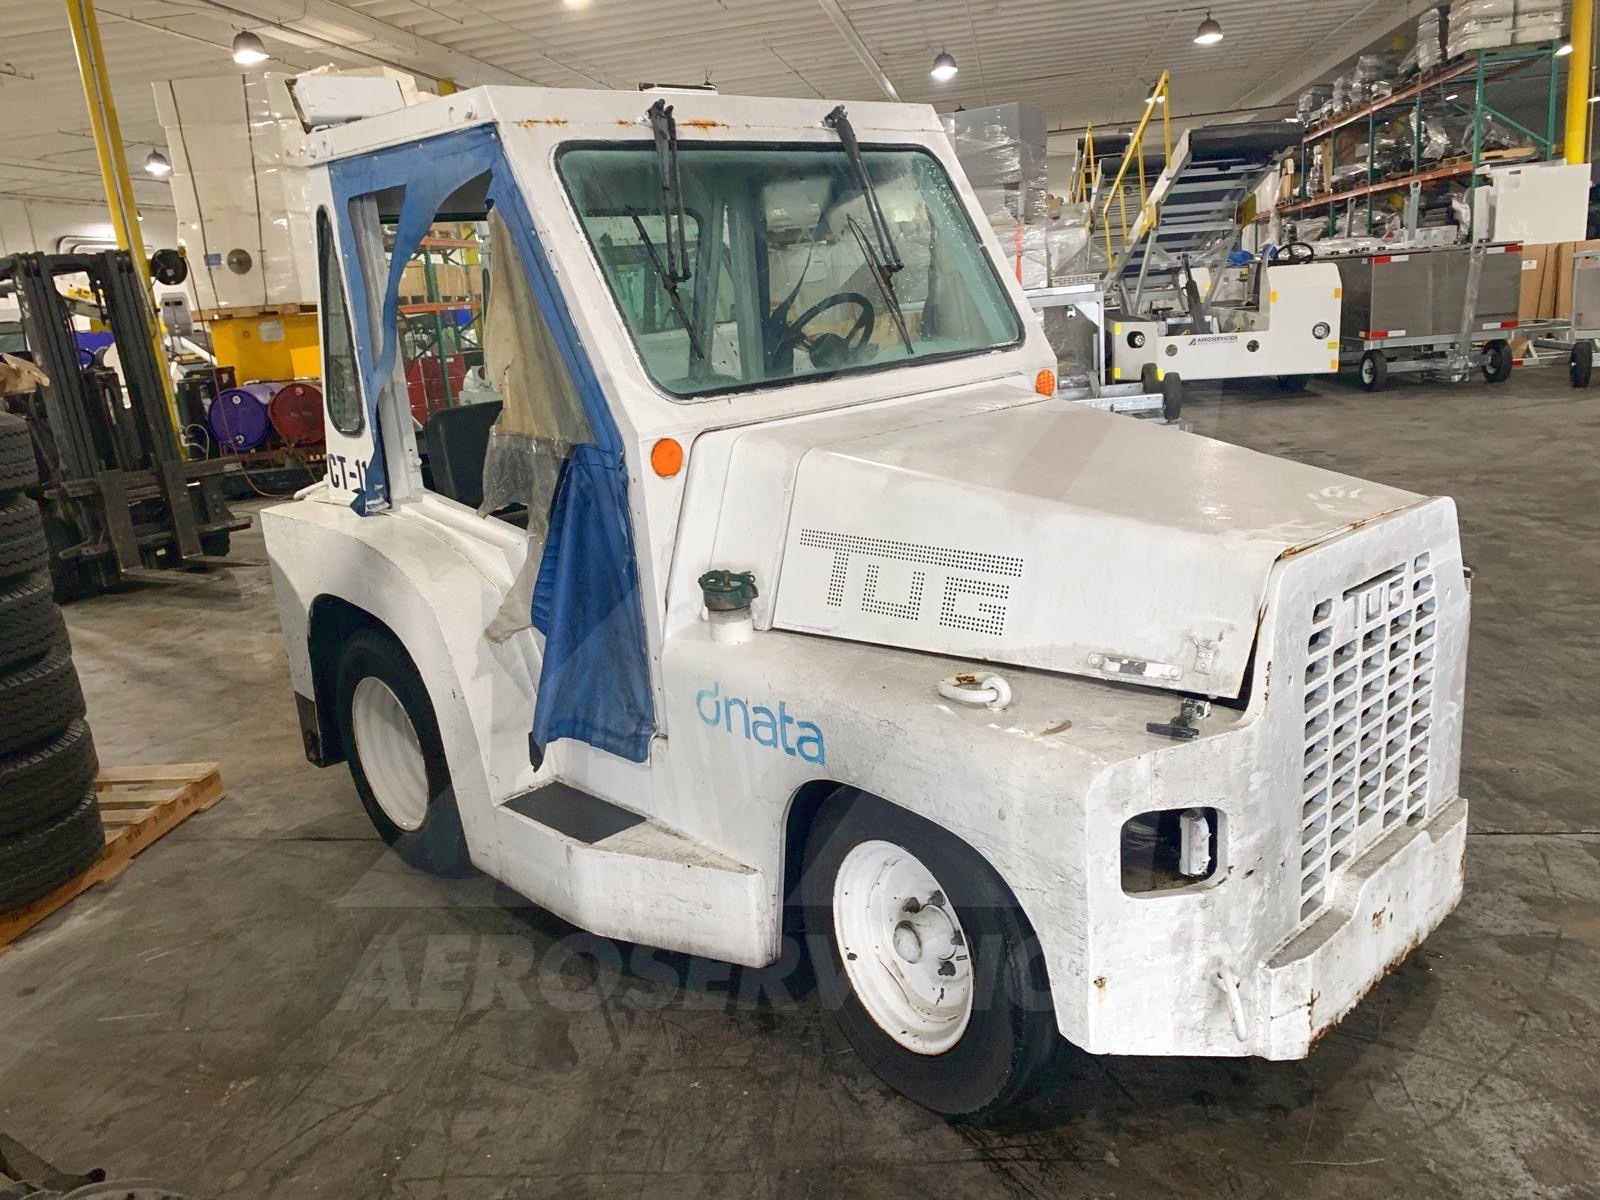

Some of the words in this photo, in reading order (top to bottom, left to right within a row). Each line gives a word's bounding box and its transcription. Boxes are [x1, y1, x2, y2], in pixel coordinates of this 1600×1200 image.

[799, 528, 1024, 637] TUG
[1341, 562, 1407, 630] TUG
[696, 680, 826, 767] dnata
